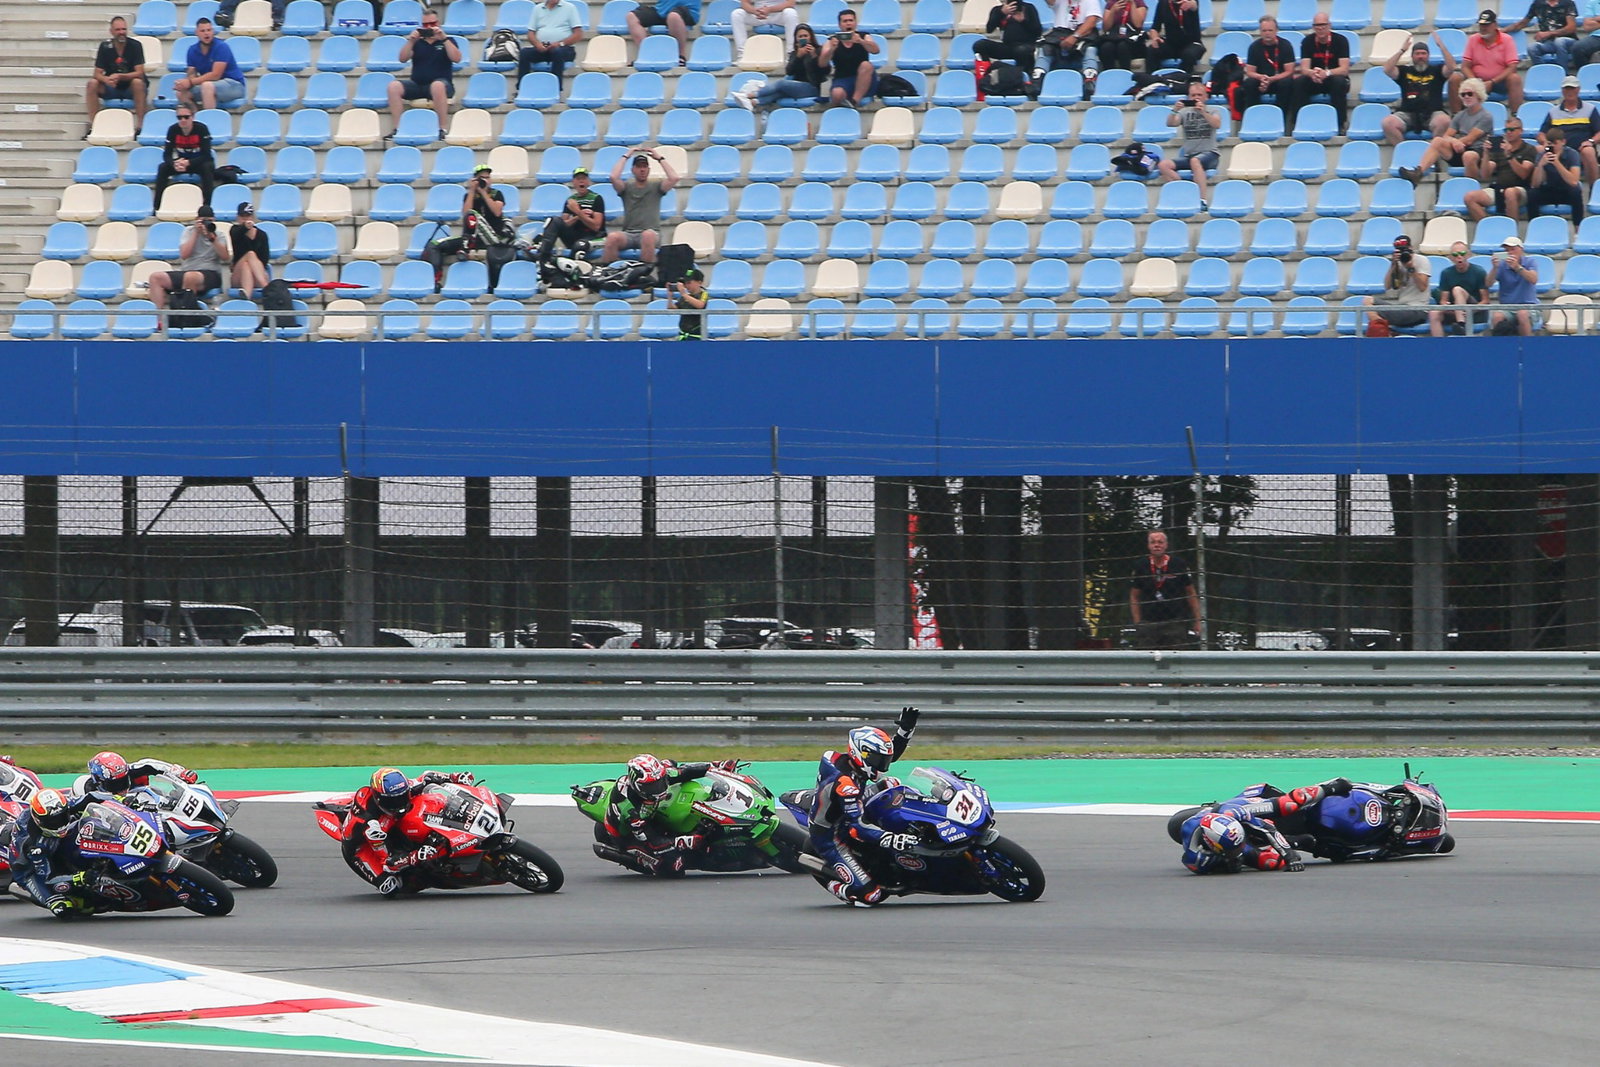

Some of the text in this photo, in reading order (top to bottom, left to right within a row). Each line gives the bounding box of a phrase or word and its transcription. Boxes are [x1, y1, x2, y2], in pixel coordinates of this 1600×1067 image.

[14, 778, 35, 801] 91
[735, 790, 753, 808] 1
[182, 795, 200, 818] 66
[955, 794, 974, 821] 31
[478, 810, 498, 834] 21
[130, 825, 153, 854] 55
[456, 838, 478, 851] Lenovo
[124, 861, 146, 875] YAMAHA
[843, 853, 868, 881] YAMAHA
